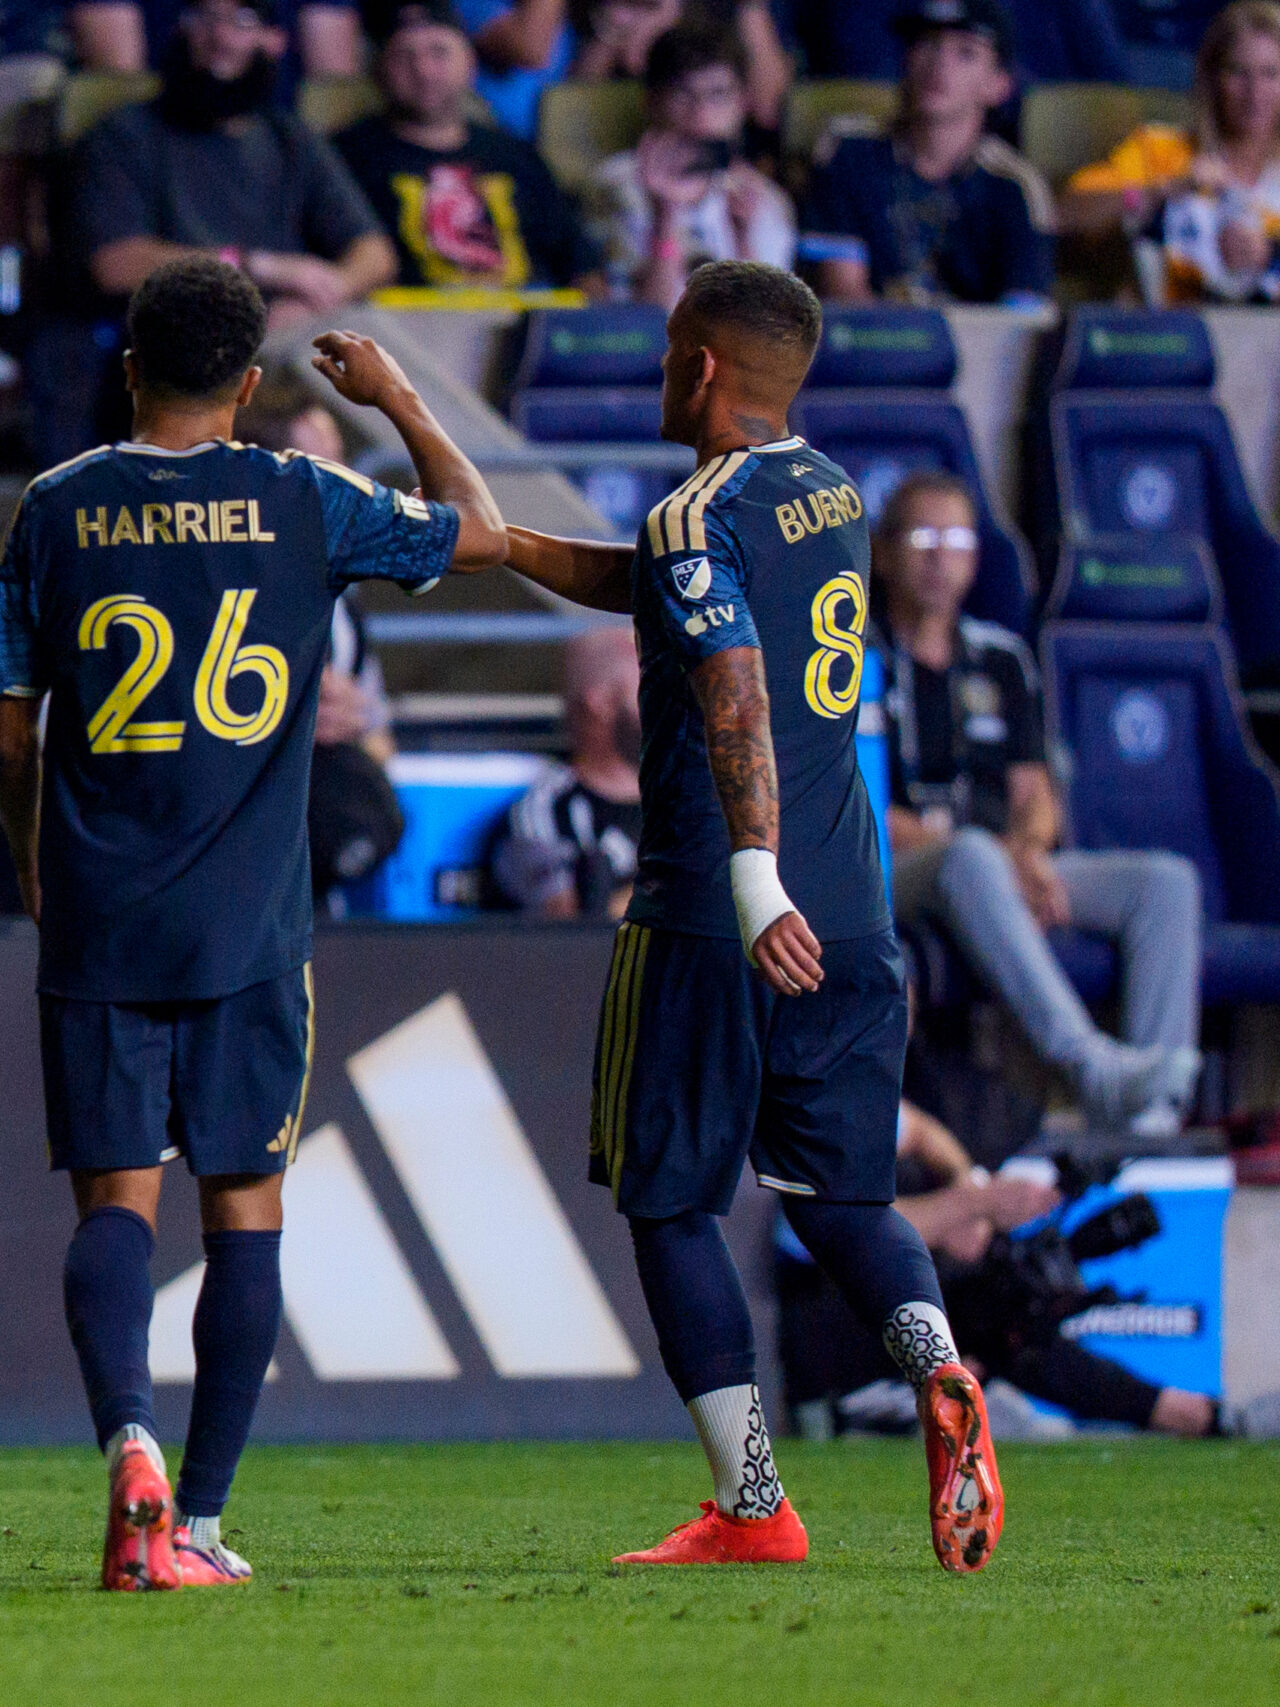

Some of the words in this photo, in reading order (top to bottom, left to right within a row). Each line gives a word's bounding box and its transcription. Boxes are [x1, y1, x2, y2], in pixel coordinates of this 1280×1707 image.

[76, 499, 276, 549] HARRIEL
[775, 484, 863, 544] BUENO
[675, 562, 696, 577] MLS
[704, 603, 735, 627] tv
[78, 588, 290, 754] 26
[804, 570, 867, 719] 8
